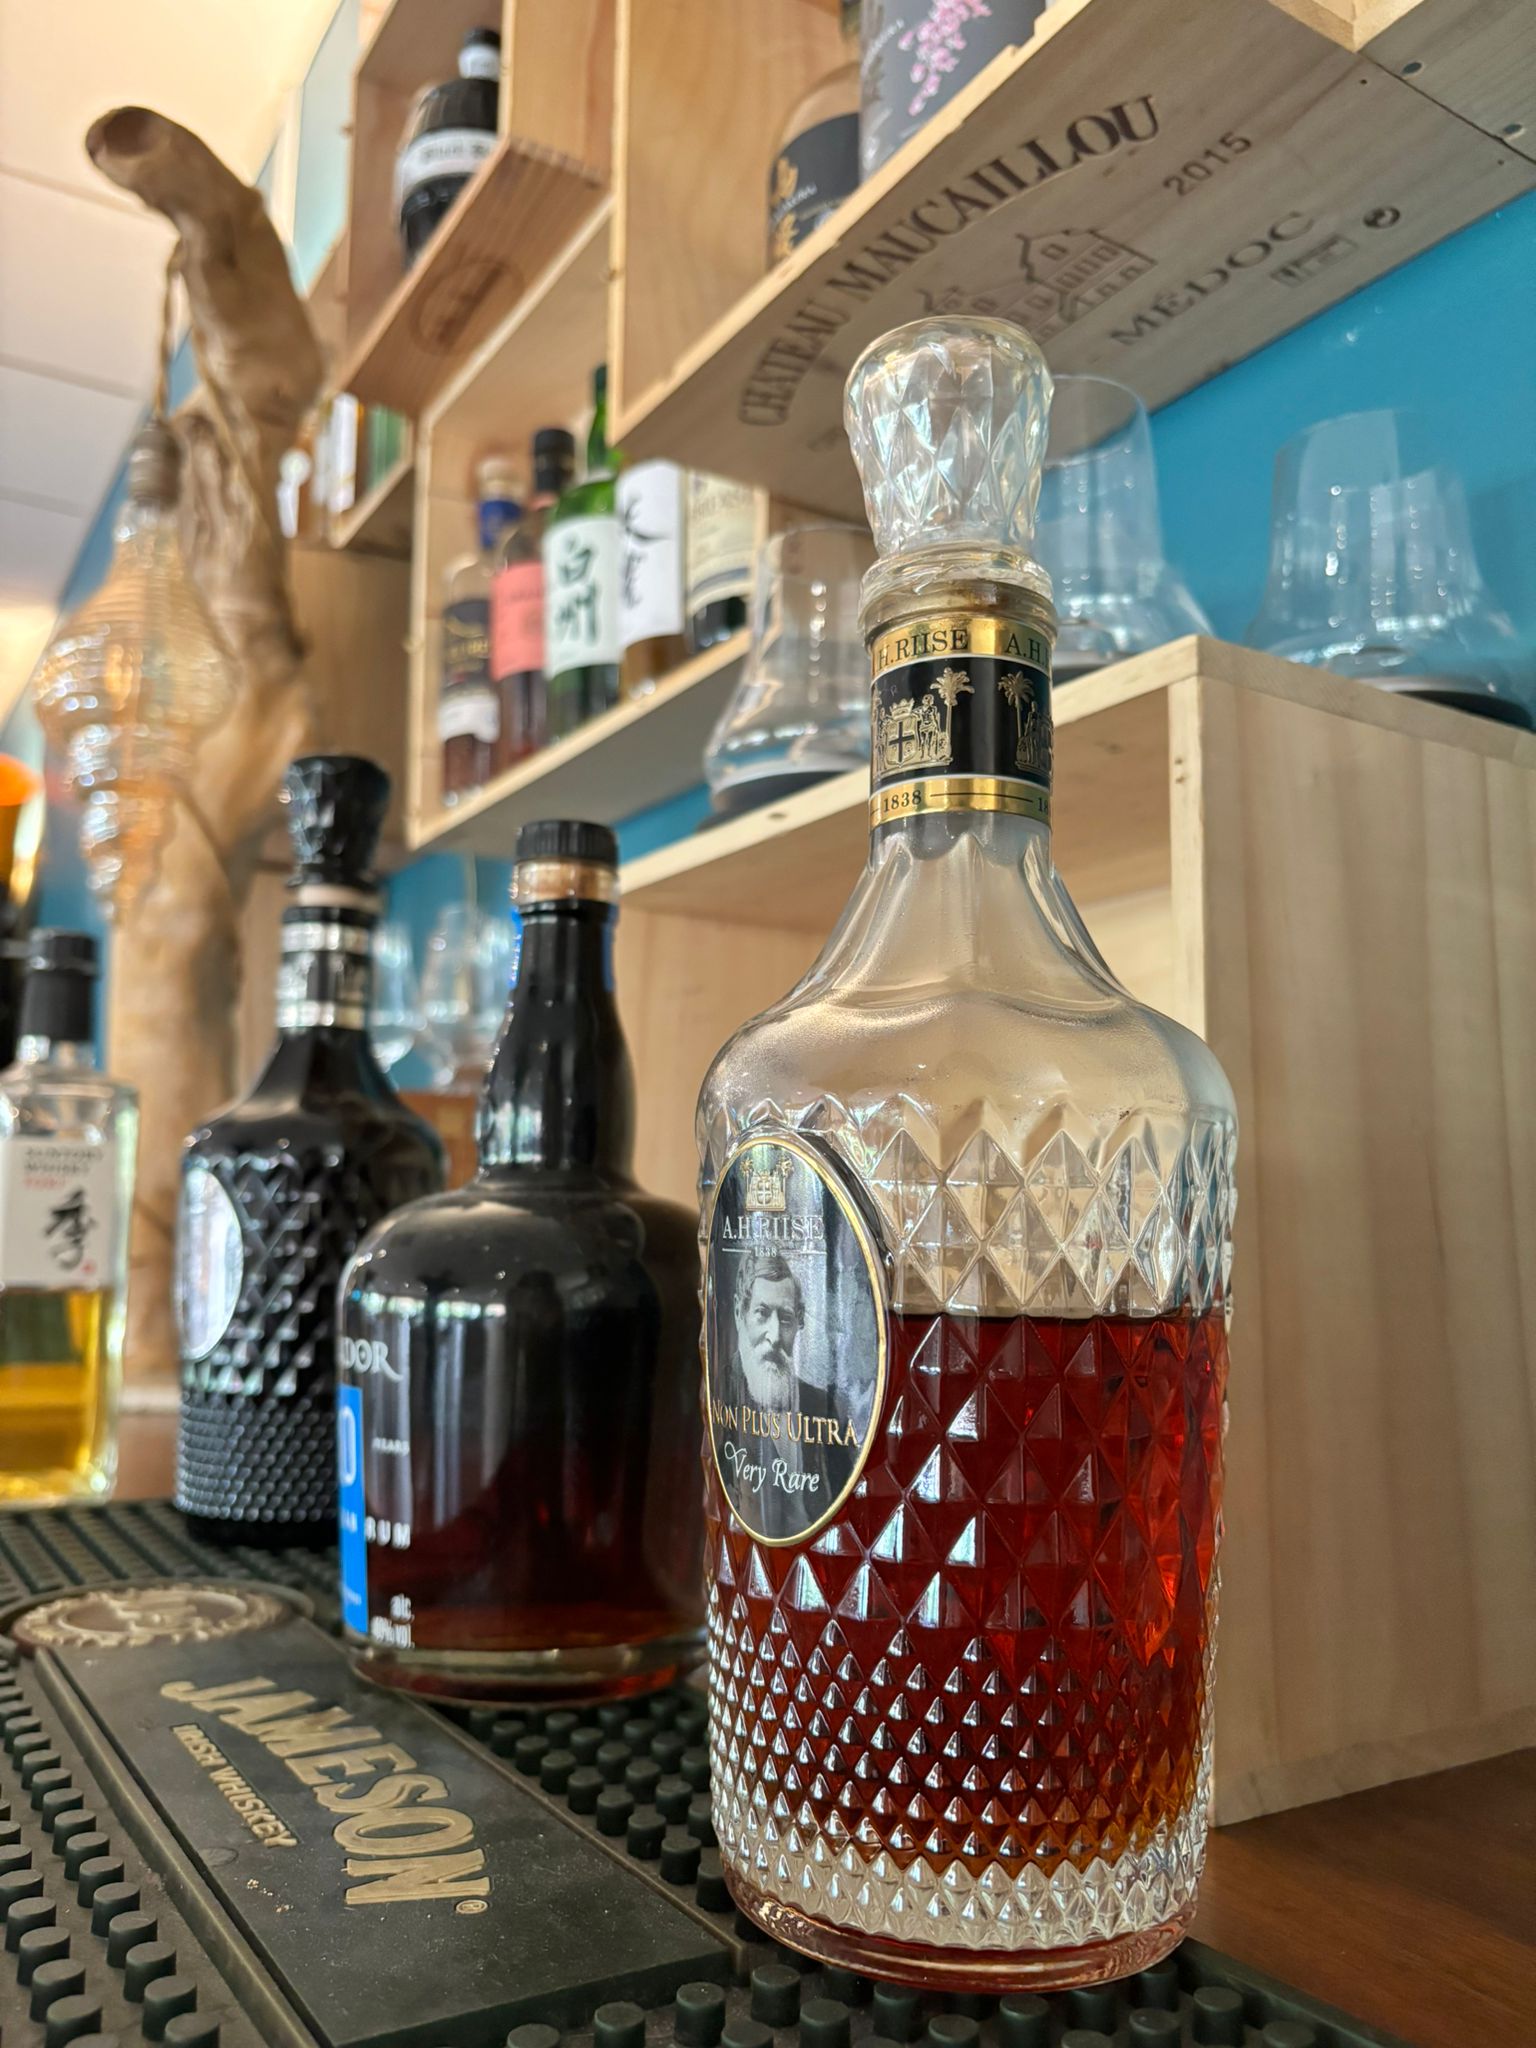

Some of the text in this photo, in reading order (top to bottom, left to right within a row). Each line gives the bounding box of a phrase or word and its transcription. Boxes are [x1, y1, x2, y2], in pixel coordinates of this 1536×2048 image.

[1163, 131, 1252, 196] 2015
[826, 94, 1160, 302] MAUCAILLOU
[883, 789, 922, 813] 1838
[722, 1215, 825, 1241] A.H.RIISE
[754, 1246, 777, 1258] 1838
[711, 1399, 859, 1447] NON PLUS ULTRA
[724, 1441, 820, 1494] Very Rare
[365, 1516, 411, 1549] RUM
[160, 1676, 491, 1905] JAMESON
[172, 1724, 298, 1848] IRISH WHISKEY
